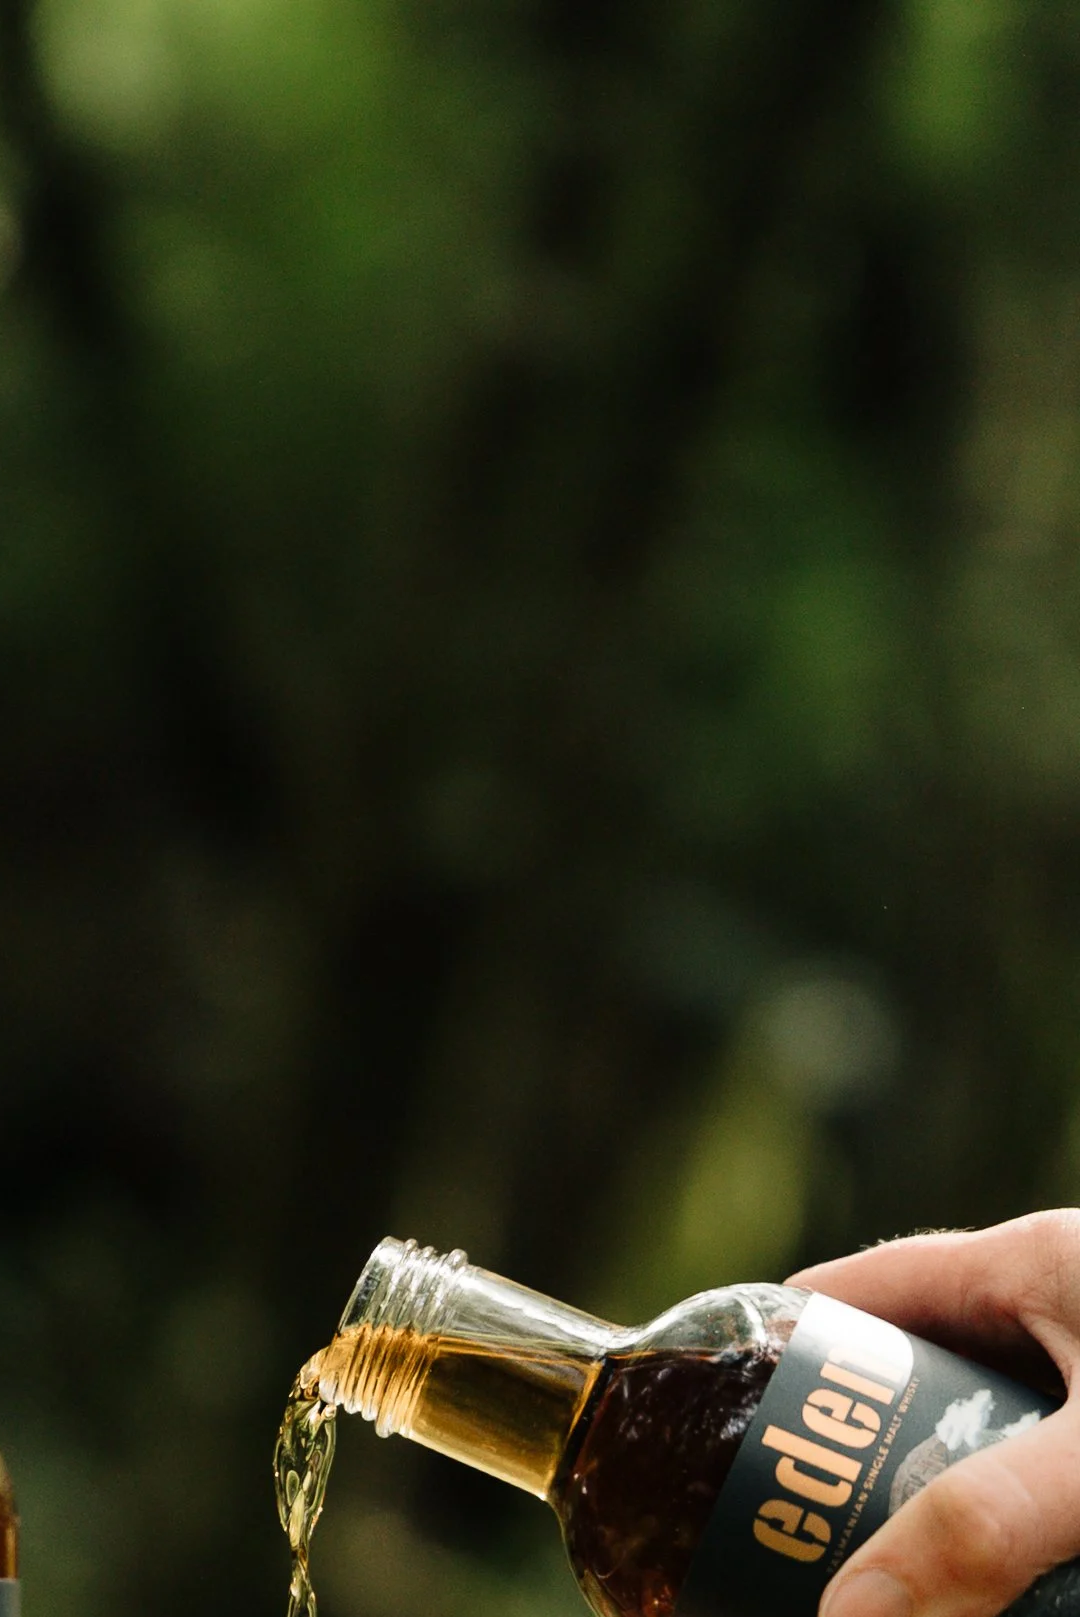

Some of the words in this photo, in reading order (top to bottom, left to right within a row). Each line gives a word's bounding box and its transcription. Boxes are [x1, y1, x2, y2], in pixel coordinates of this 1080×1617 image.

[753, 1347, 904, 1563] eden
[863, 1446, 890, 1491] SINGLE
[883, 1414, 903, 1447] MALT
